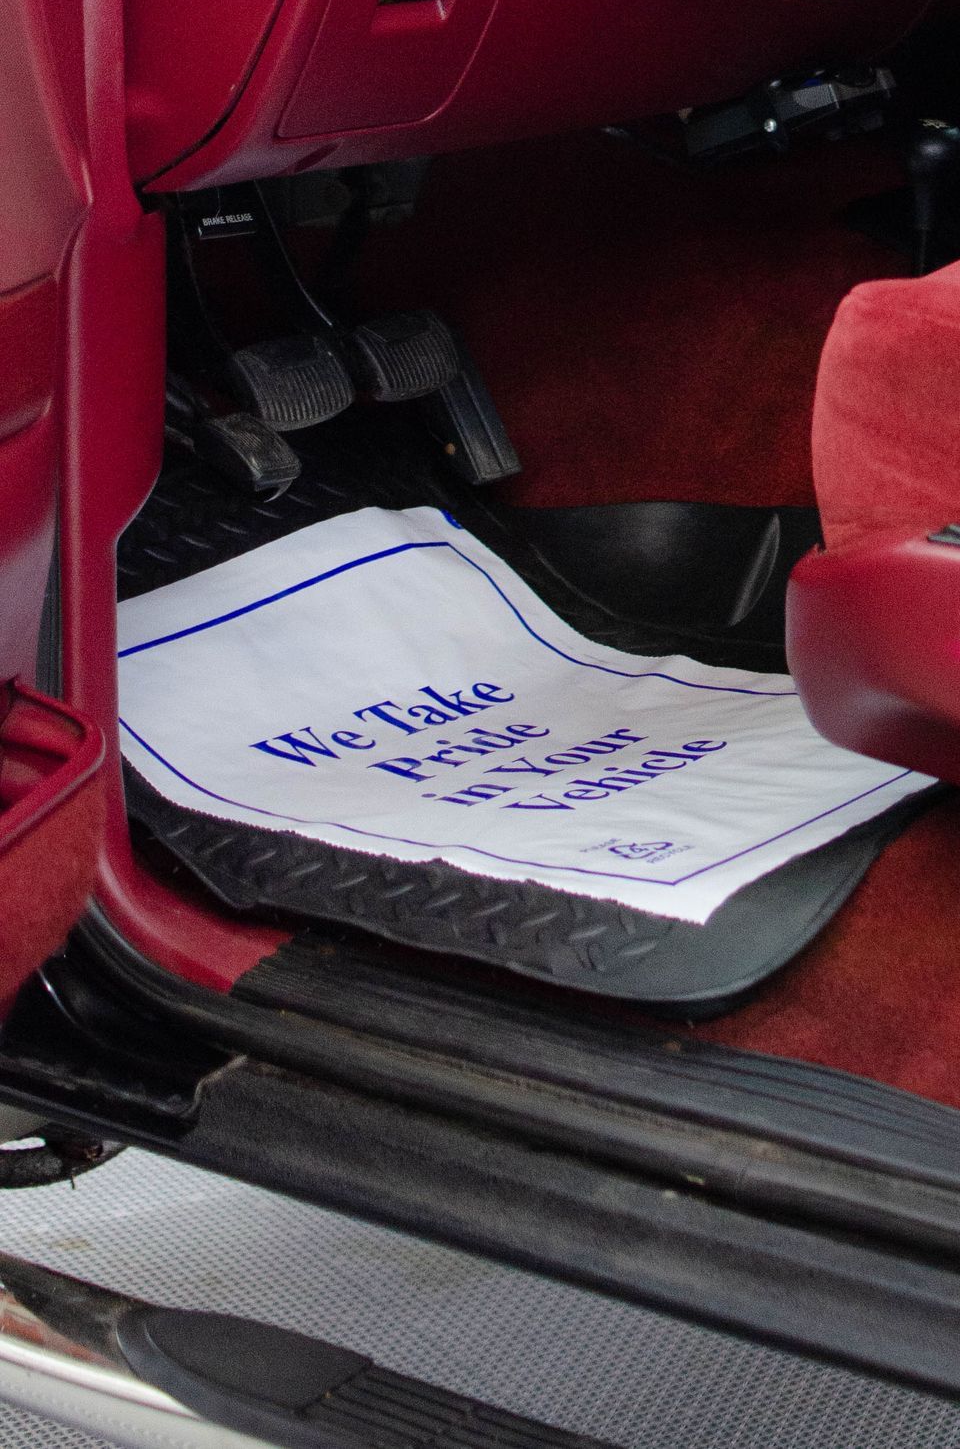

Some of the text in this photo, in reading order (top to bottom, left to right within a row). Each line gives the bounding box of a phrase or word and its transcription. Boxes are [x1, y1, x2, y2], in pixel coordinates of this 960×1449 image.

[202, 213, 253, 226] BRAKE RELEASE
[248, 682, 515, 767] We Take
[366, 722, 551, 783] Pride
[421, 727, 650, 807] in Your
[501, 739, 728, 811] Vehicle
